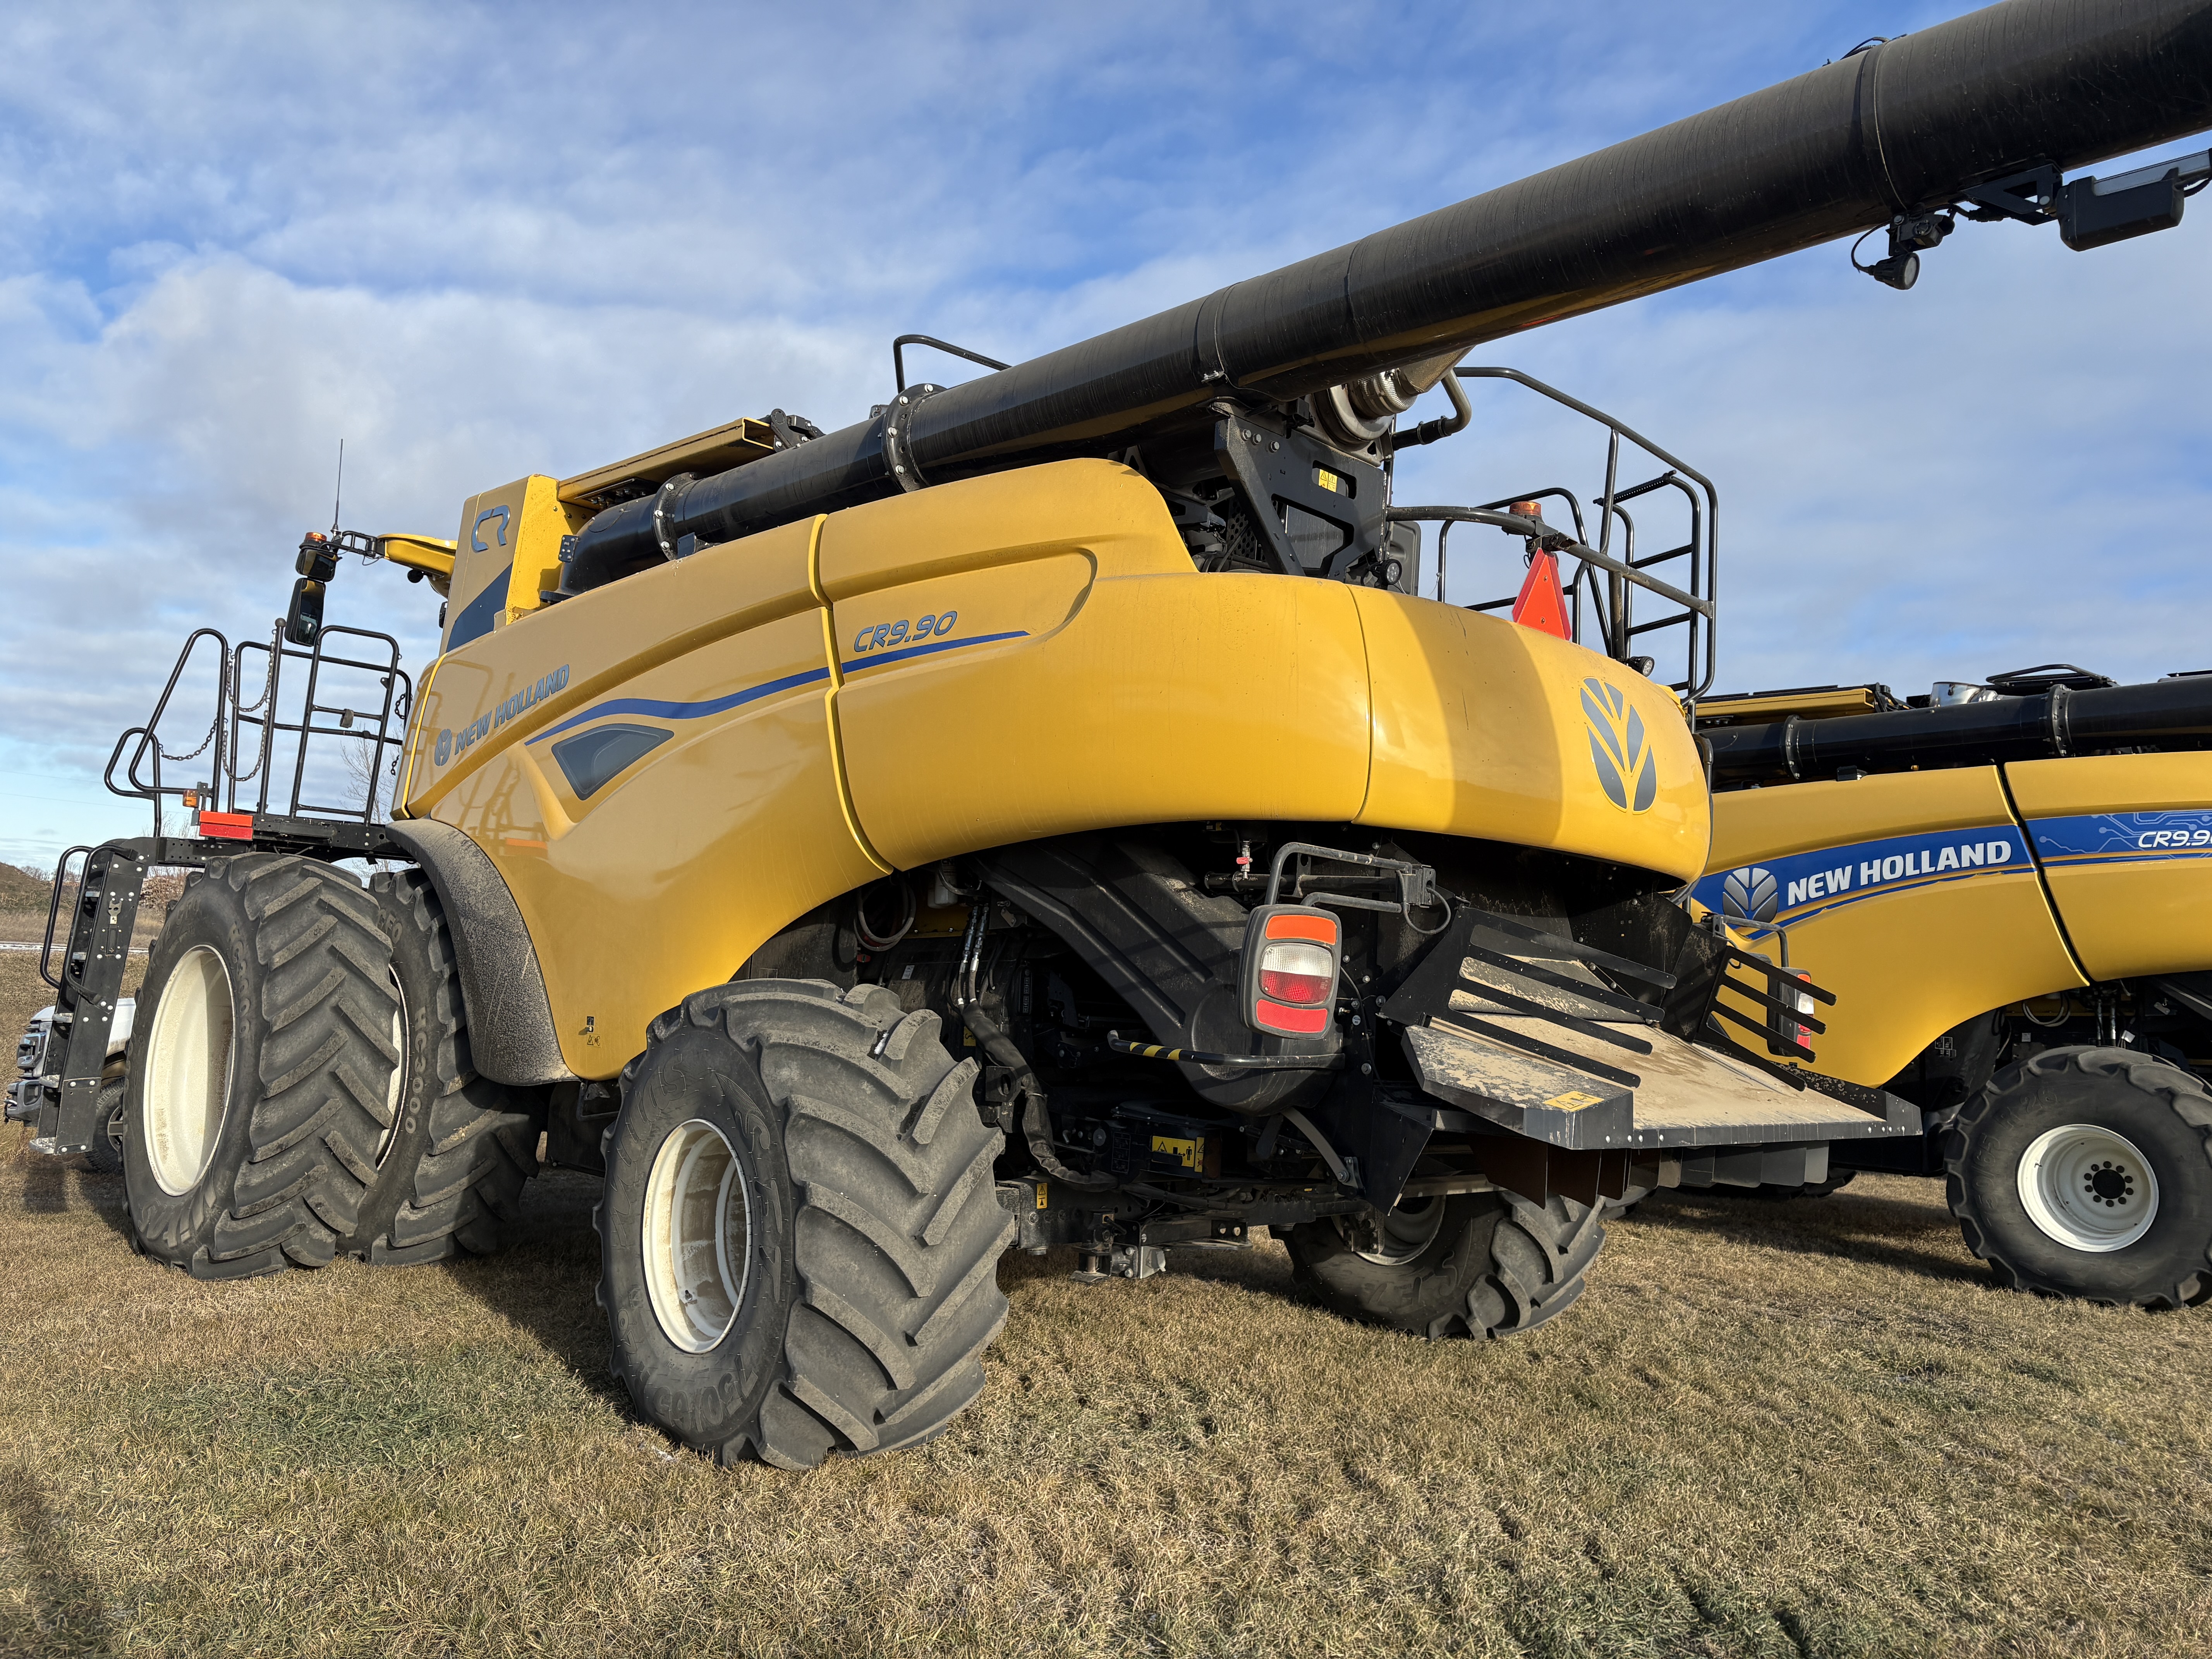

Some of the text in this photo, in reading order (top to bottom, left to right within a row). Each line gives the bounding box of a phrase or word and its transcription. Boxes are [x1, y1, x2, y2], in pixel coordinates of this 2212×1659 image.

[854, 611, 958, 652] CR9.90
[455, 664, 570, 756] NEW HOLLAND
[2138, 830, 2212, 848] CR9.9
[1788, 841, 2012, 906] NEW HOLLAND
[405, 1007, 427, 1134] HC3000
